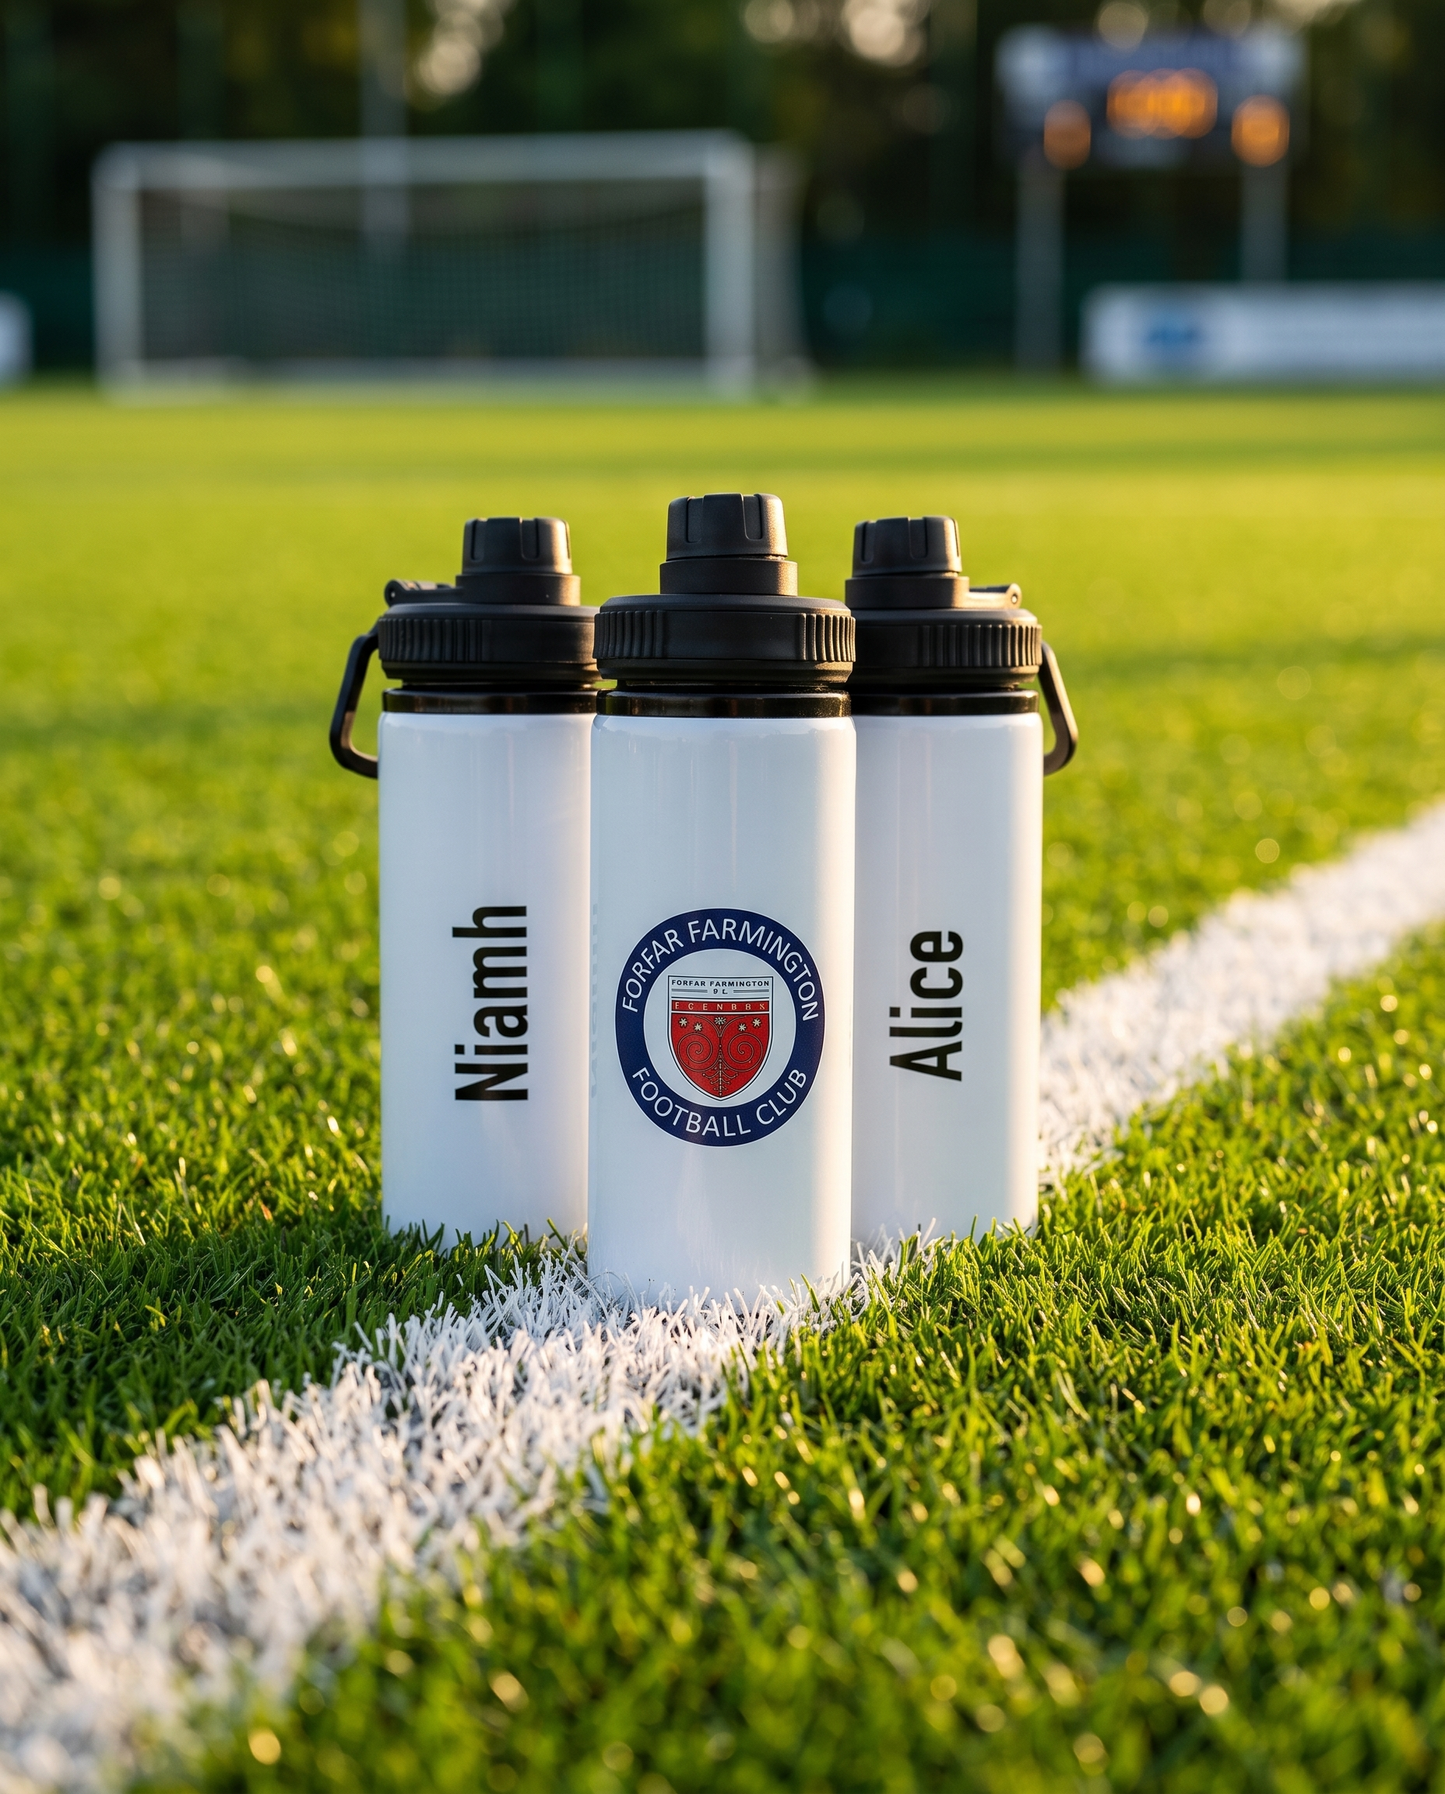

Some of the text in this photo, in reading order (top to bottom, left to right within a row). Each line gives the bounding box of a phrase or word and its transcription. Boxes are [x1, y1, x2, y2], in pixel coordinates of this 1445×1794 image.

[452, 906, 528, 1101] Niamh
[622, 929, 685, 1013] FORFAR
[687, 918, 819, 1021] FARMINGTON
[671, 979, 770, 987] FORFAR FARMINGTON
[889, 931, 963, 1081] Alice
[632, 1067, 807, 1137] FOOTBALL CLUB
